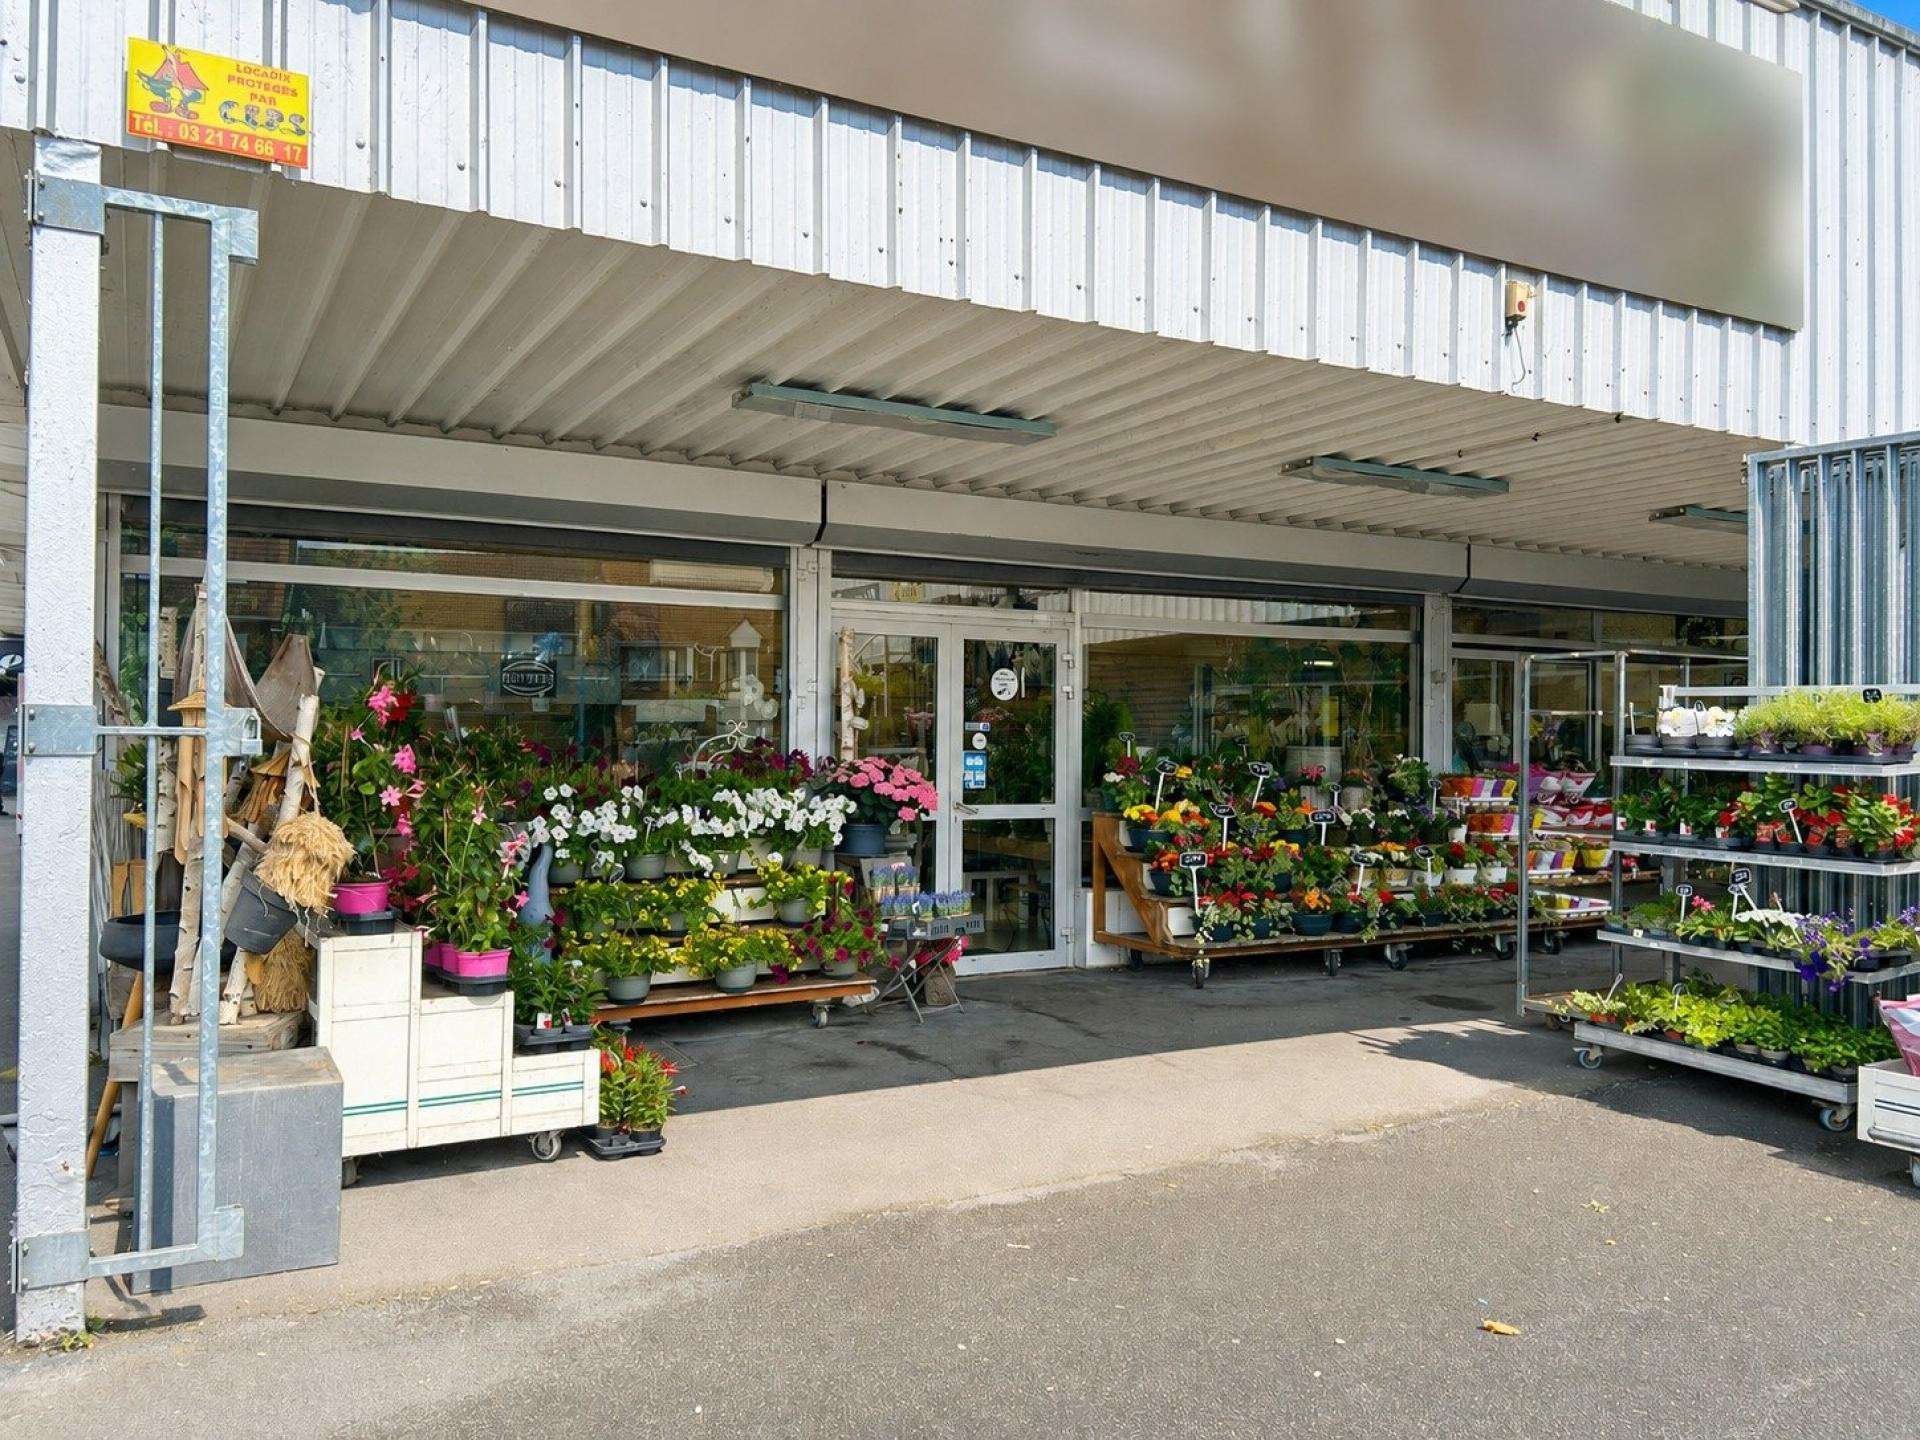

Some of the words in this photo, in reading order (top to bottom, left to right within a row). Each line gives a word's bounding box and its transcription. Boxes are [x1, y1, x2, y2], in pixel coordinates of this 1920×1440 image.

[250, 92, 276, 106] PAR
[179, 123, 200, 142] 03
[205, 127, 224, 147] 21
[230, 133, 249, 151] 74
[283, 143, 303, 161] 17
